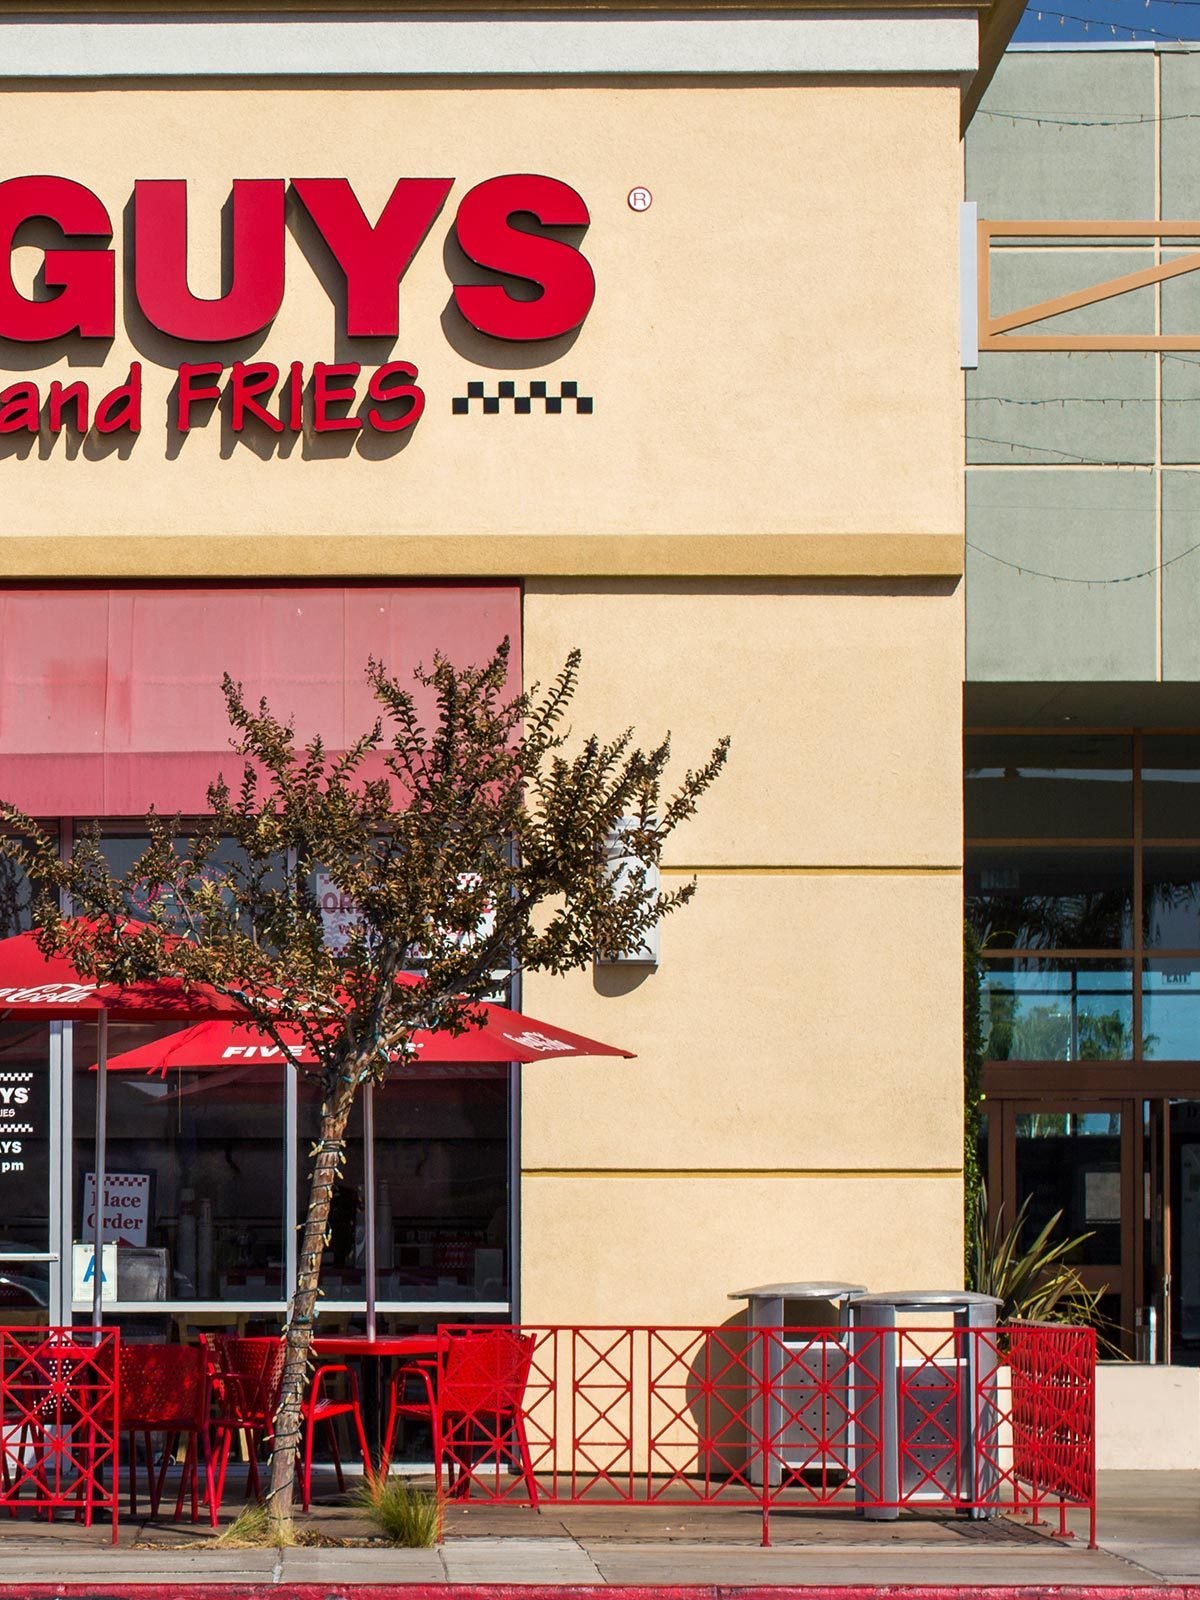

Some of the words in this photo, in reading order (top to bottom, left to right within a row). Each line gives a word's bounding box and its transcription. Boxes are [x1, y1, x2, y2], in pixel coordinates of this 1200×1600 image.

[176, 359, 427, 433] FRIES
[221, 1044, 306, 1058] FIVE
[1, 1161, 24, 1173] pm
[83, 1254, 107, 1282] A
